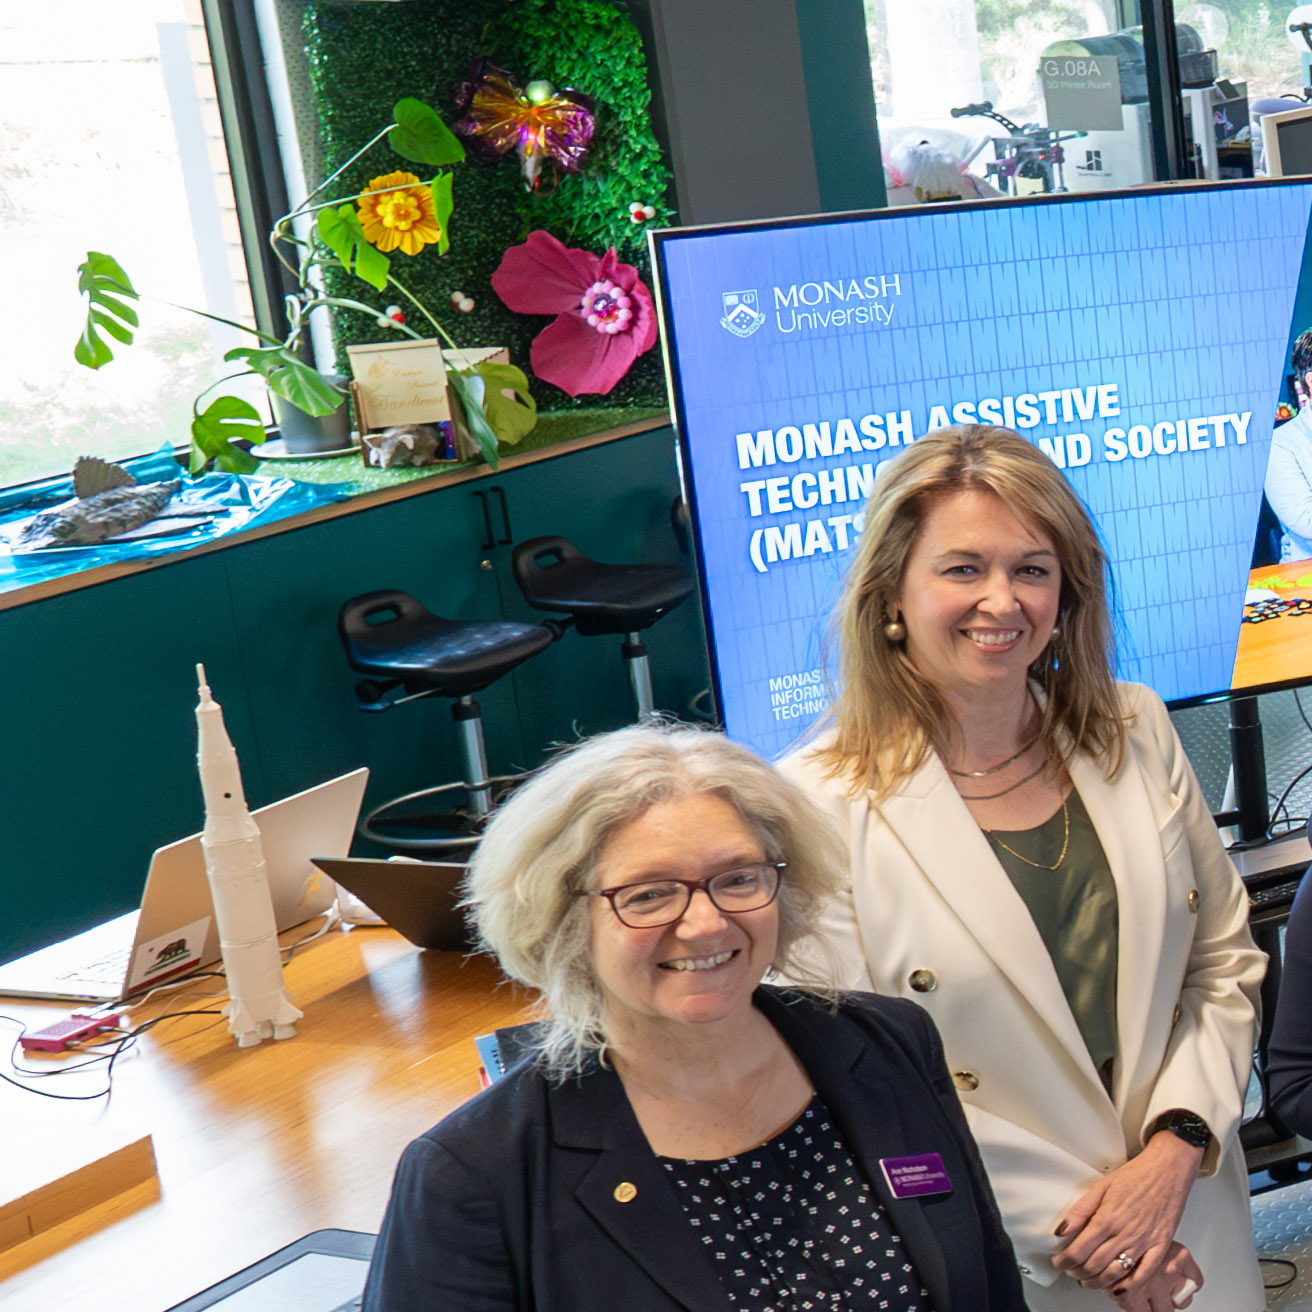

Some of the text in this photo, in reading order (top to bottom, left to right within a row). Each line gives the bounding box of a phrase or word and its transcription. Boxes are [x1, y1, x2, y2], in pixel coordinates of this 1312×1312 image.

[1044, 60, 1101, 76] G.08A
[774, 274, 902, 310] MONASH
[776, 301, 895, 333] University
[736, 383, 1121, 469] MONASH ASSISTIVE
[1040, 433, 1092, 470] ND
[1103, 411, 1252, 463] SOCIETY
[769, 669, 821, 692] MONAS
[771, 684, 825, 707] INFORM
[772, 698, 829, 720] TECHNO
